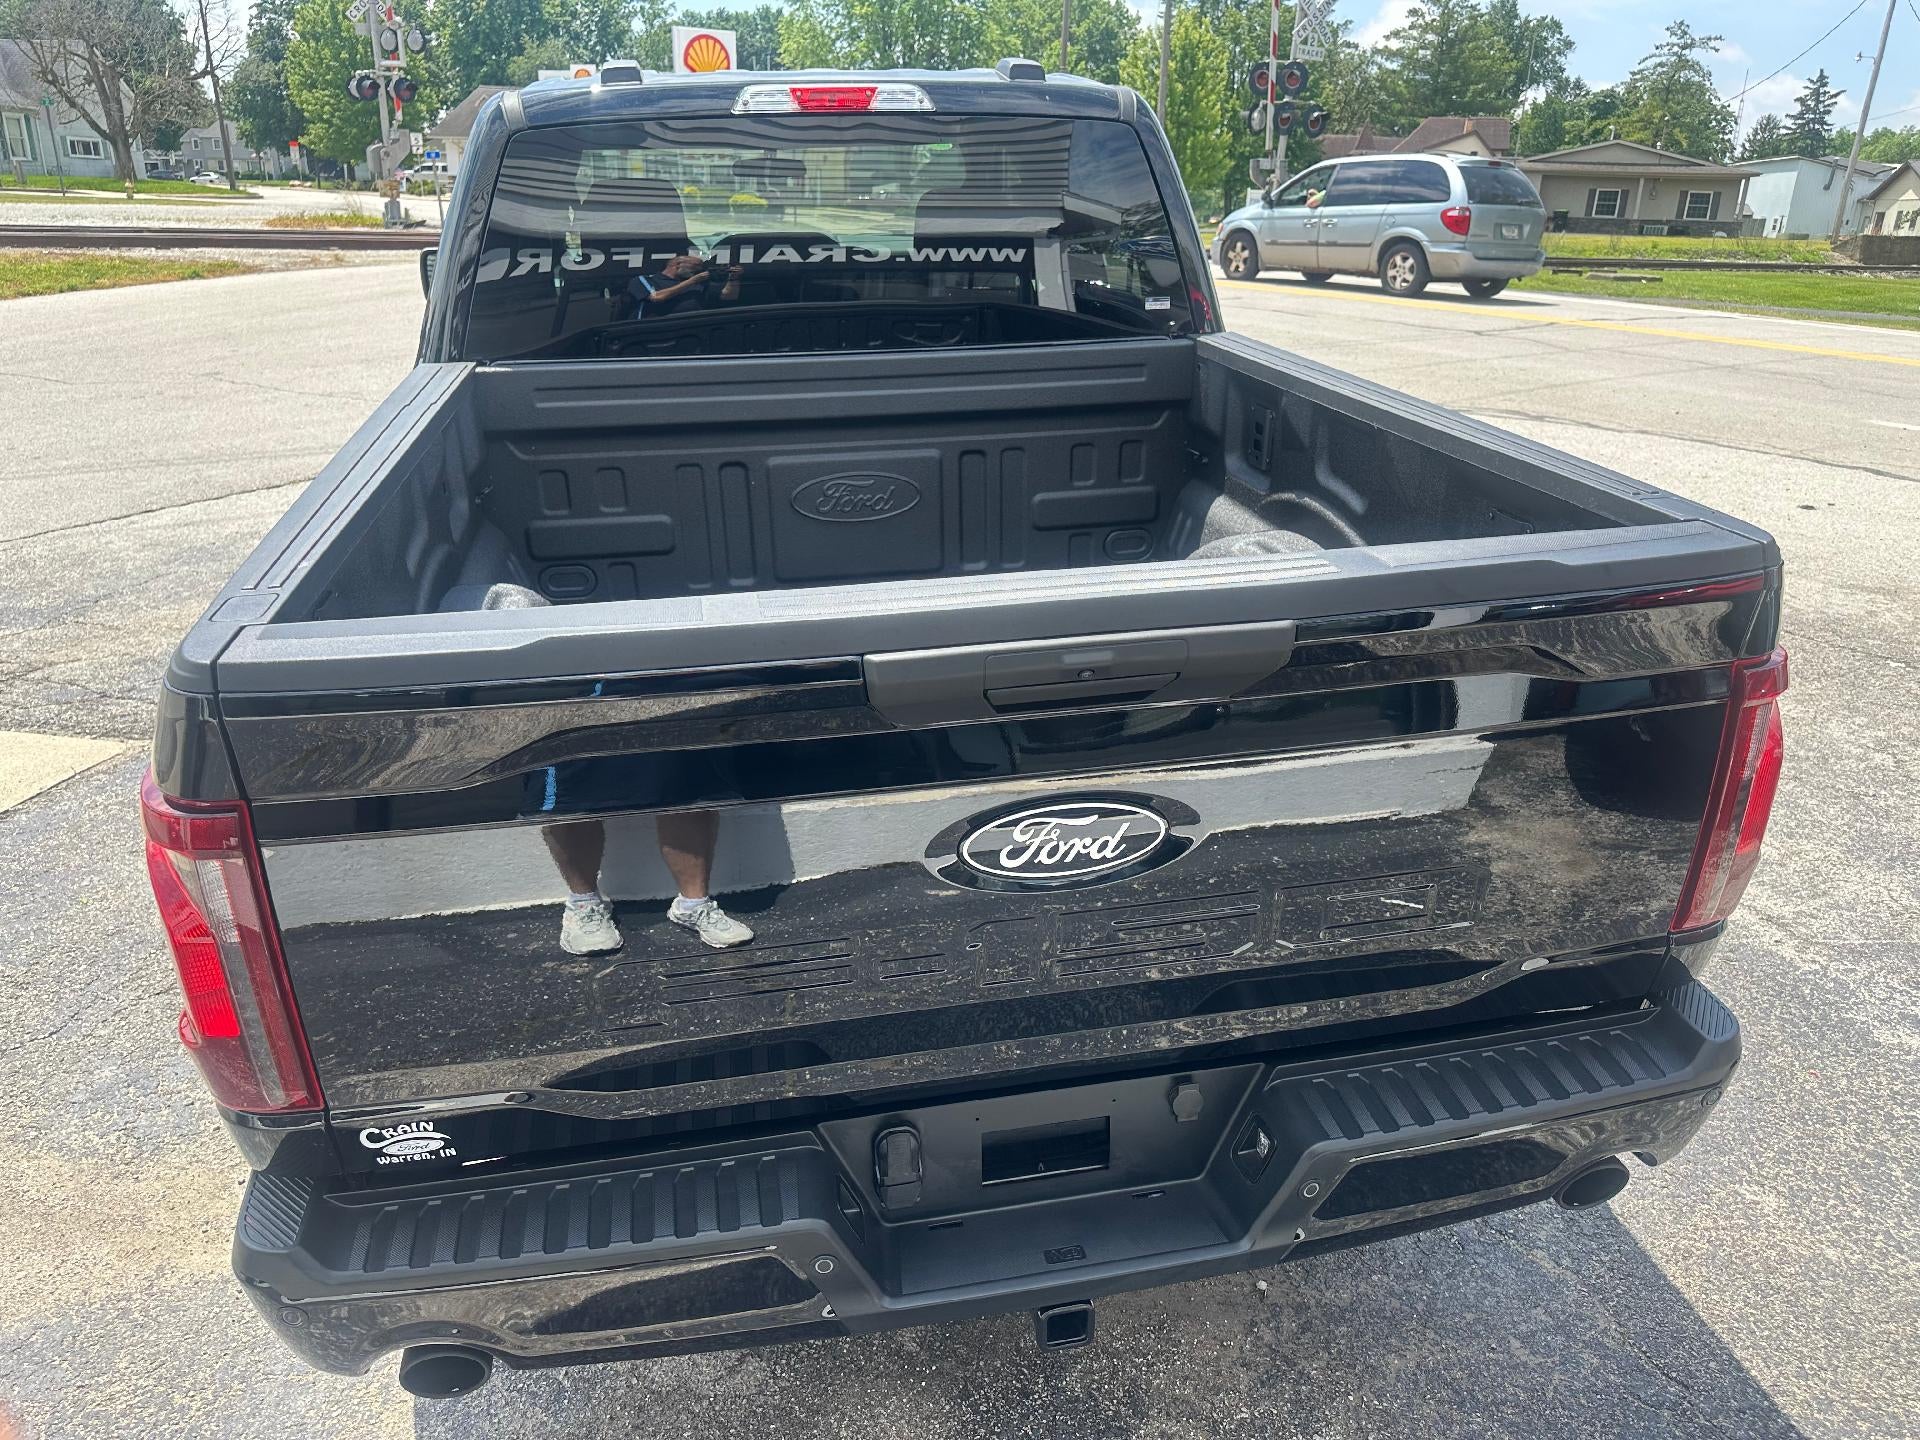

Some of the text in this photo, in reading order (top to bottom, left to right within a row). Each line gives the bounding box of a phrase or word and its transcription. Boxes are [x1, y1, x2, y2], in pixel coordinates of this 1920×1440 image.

[1296, 0, 1333, 39] CROSSIN
[1310, 35, 1316, 47] 2
[816, 478, 896, 514] Ford
[999, 814, 1130, 869] Ford
[397, 1142, 431, 1153] Ford
[439, 1147, 457, 1159] IN
